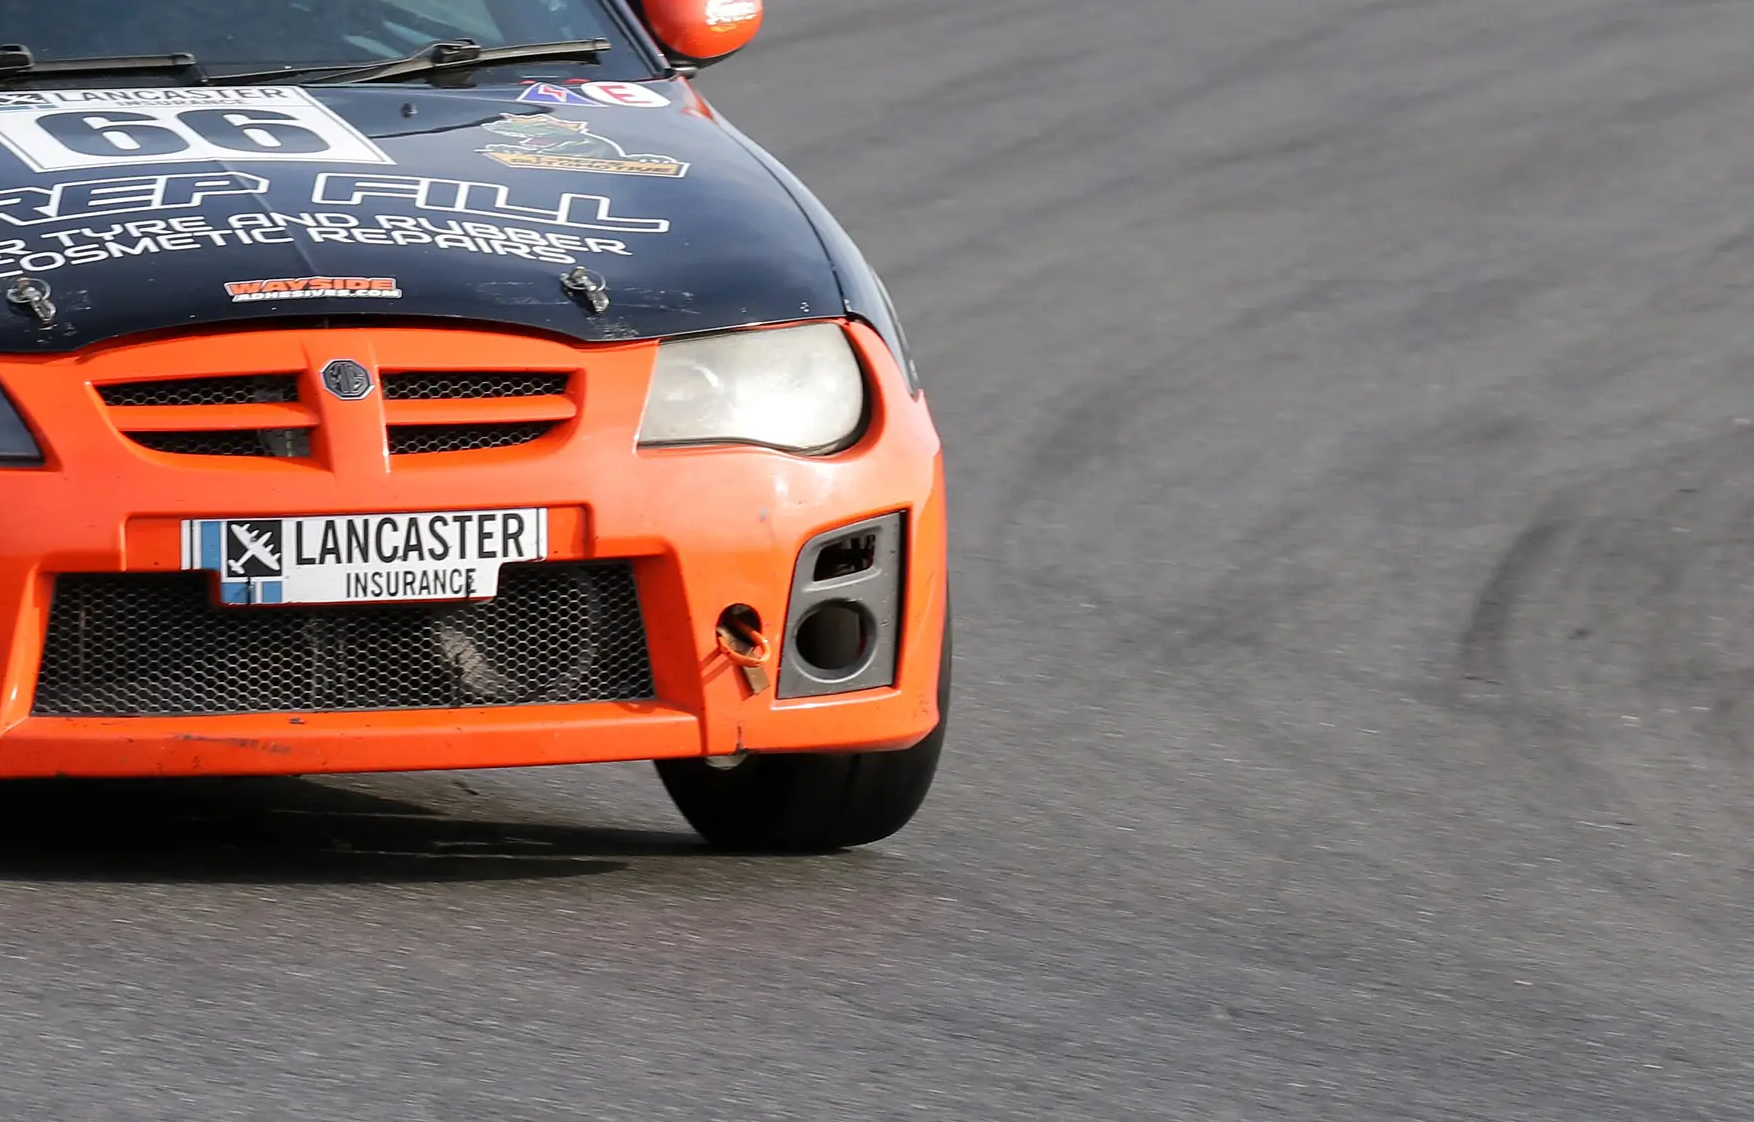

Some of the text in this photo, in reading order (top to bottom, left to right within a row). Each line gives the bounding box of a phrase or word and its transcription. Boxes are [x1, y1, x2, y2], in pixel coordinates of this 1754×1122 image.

[53, 87, 289, 104] LANCASTER
[598, 84, 653, 104] E
[36, 108, 332, 157] 66
[310, 172, 671, 234] FILL
[40, 215, 218, 248] TYRE
[227, 212, 360, 230] AND
[375, 214, 634, 256] RUBBER
[305, 227, 578, 265] REPAIRS
[228, 277, 394, 295] WAYSIDE
[234, 288, 401, 302] ADHESIVES.COM
[295, 512, 525, 566] LANCASTER
[345, 567, 477, 599] INSURANCE
